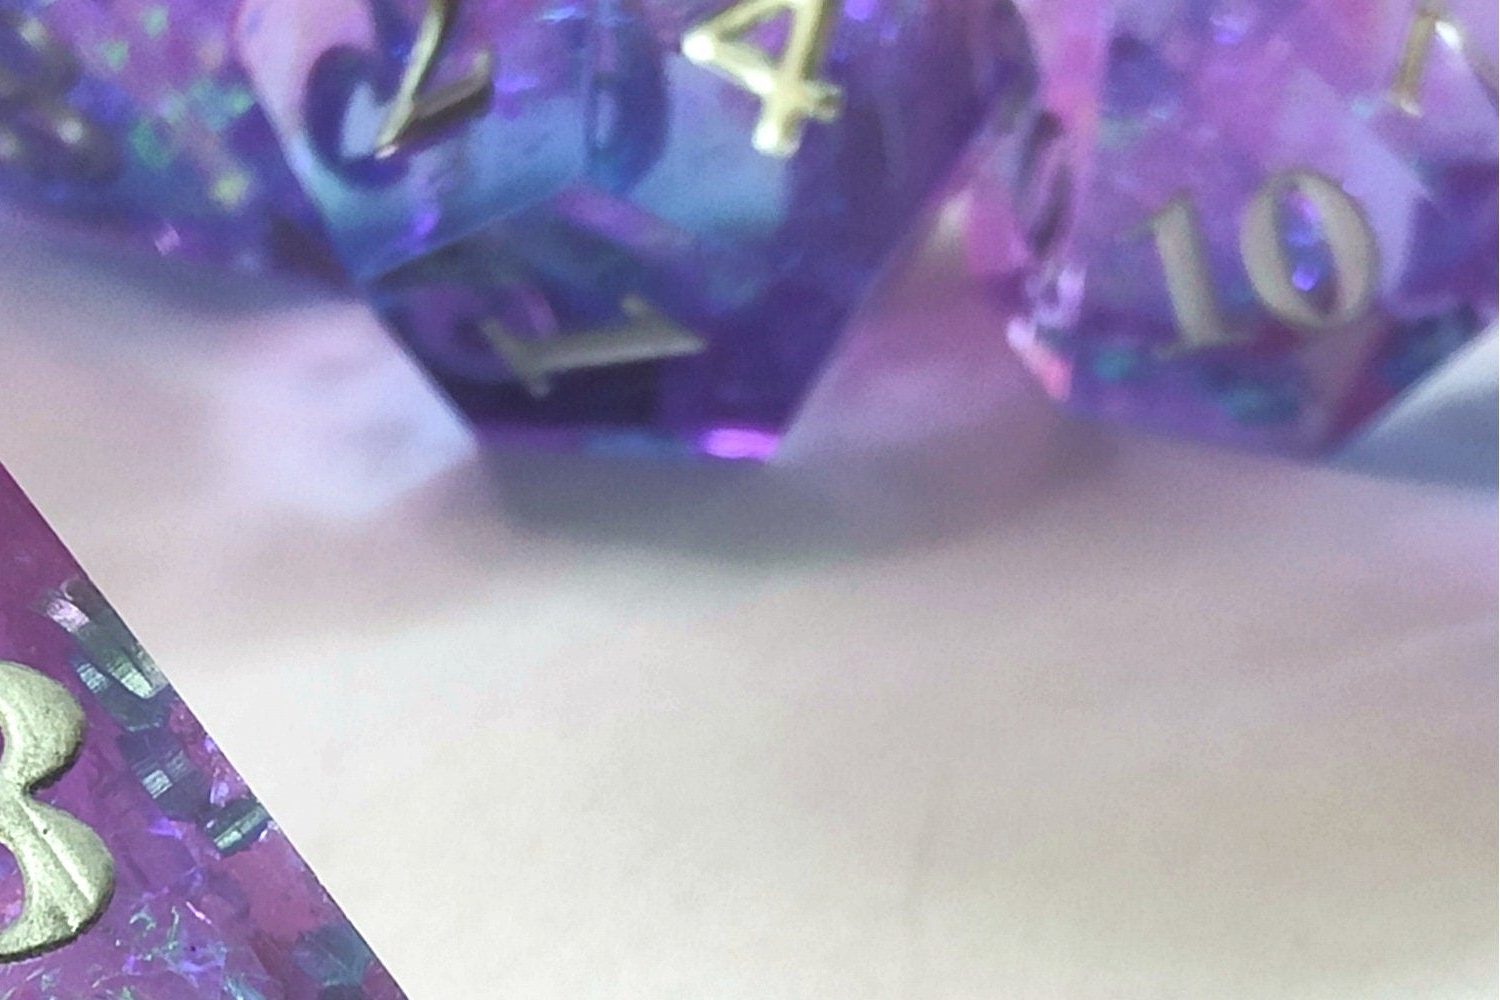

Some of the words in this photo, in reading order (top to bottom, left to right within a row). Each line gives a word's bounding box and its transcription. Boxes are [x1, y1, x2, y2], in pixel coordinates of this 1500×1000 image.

[680, 0, 842, 158] 4
[1114, 166, 1382, 361] 10
[478, 295, 706, 396] 1
